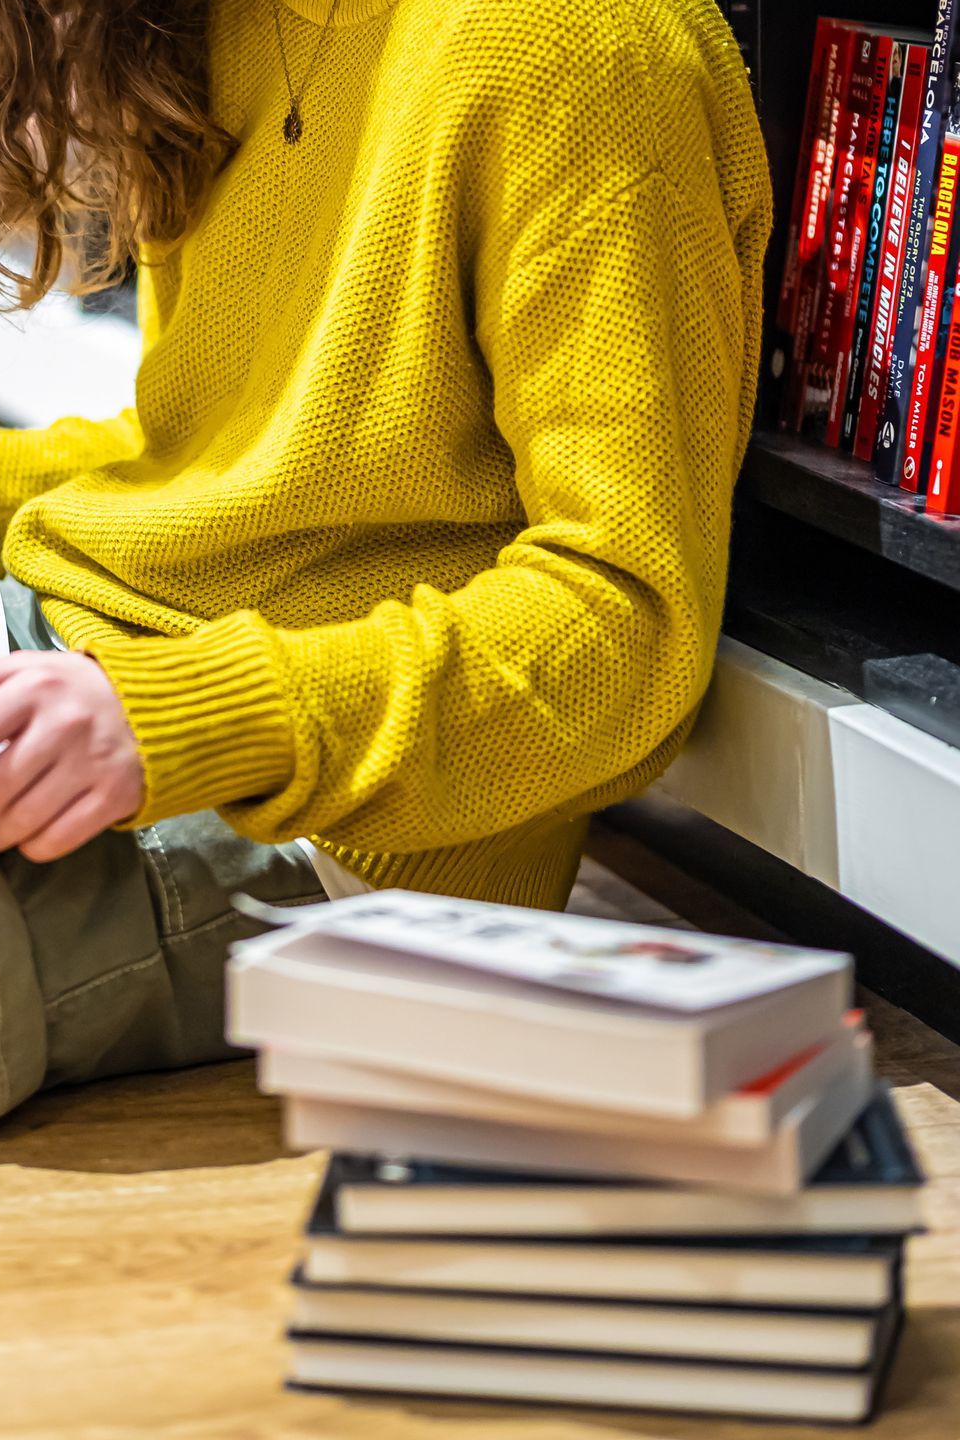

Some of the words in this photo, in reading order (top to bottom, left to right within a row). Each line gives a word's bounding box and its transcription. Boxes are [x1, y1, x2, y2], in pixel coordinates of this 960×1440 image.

[941, 24, 949, 55] ROAD
[816, 43, 838, 164] MANCHESTER
[823, 97, 840, 184] ANATOMY
[880, 98, 896, 158] HERE
[901, 140, 911, 151] I
[859, 95, 884, 206] IMMORTALS
[831, 112, 860, 270] MANCHESTER'S
[887, 157, 910, 244] BELIEVE
[914, 170, 922, 195] AND
[807, 170, 822, 239] UNITED
[912, 198, 919, 218] MY
[917, 197, 925, 219] THE
[931, 153, 957, 255] BARCELONA
[908, 220, 916, 243] LIFE
[911, 224, 921, 262] GLORY
[859, 203, 882, 323] COMPETE
[883, 252, 896, 280] IN
[908, 265, 916, 283] OF
[897, 263, 910, 325] FOOTBALL
[925, 270, 934, 300] HISTORY
[929, 284, 938, 319] GREATEST
[868, 285, 892, 400] MIRACLES
[920, 307, 930, 340] RANGERS
[887, 354, 898, 399] SMITH
[894, 360, 905, 398] DAVE
[916, 363, 927, 396] TOM
[939, 367, 959, 437] MASON
[908, 400, 922, 449] MILLER
